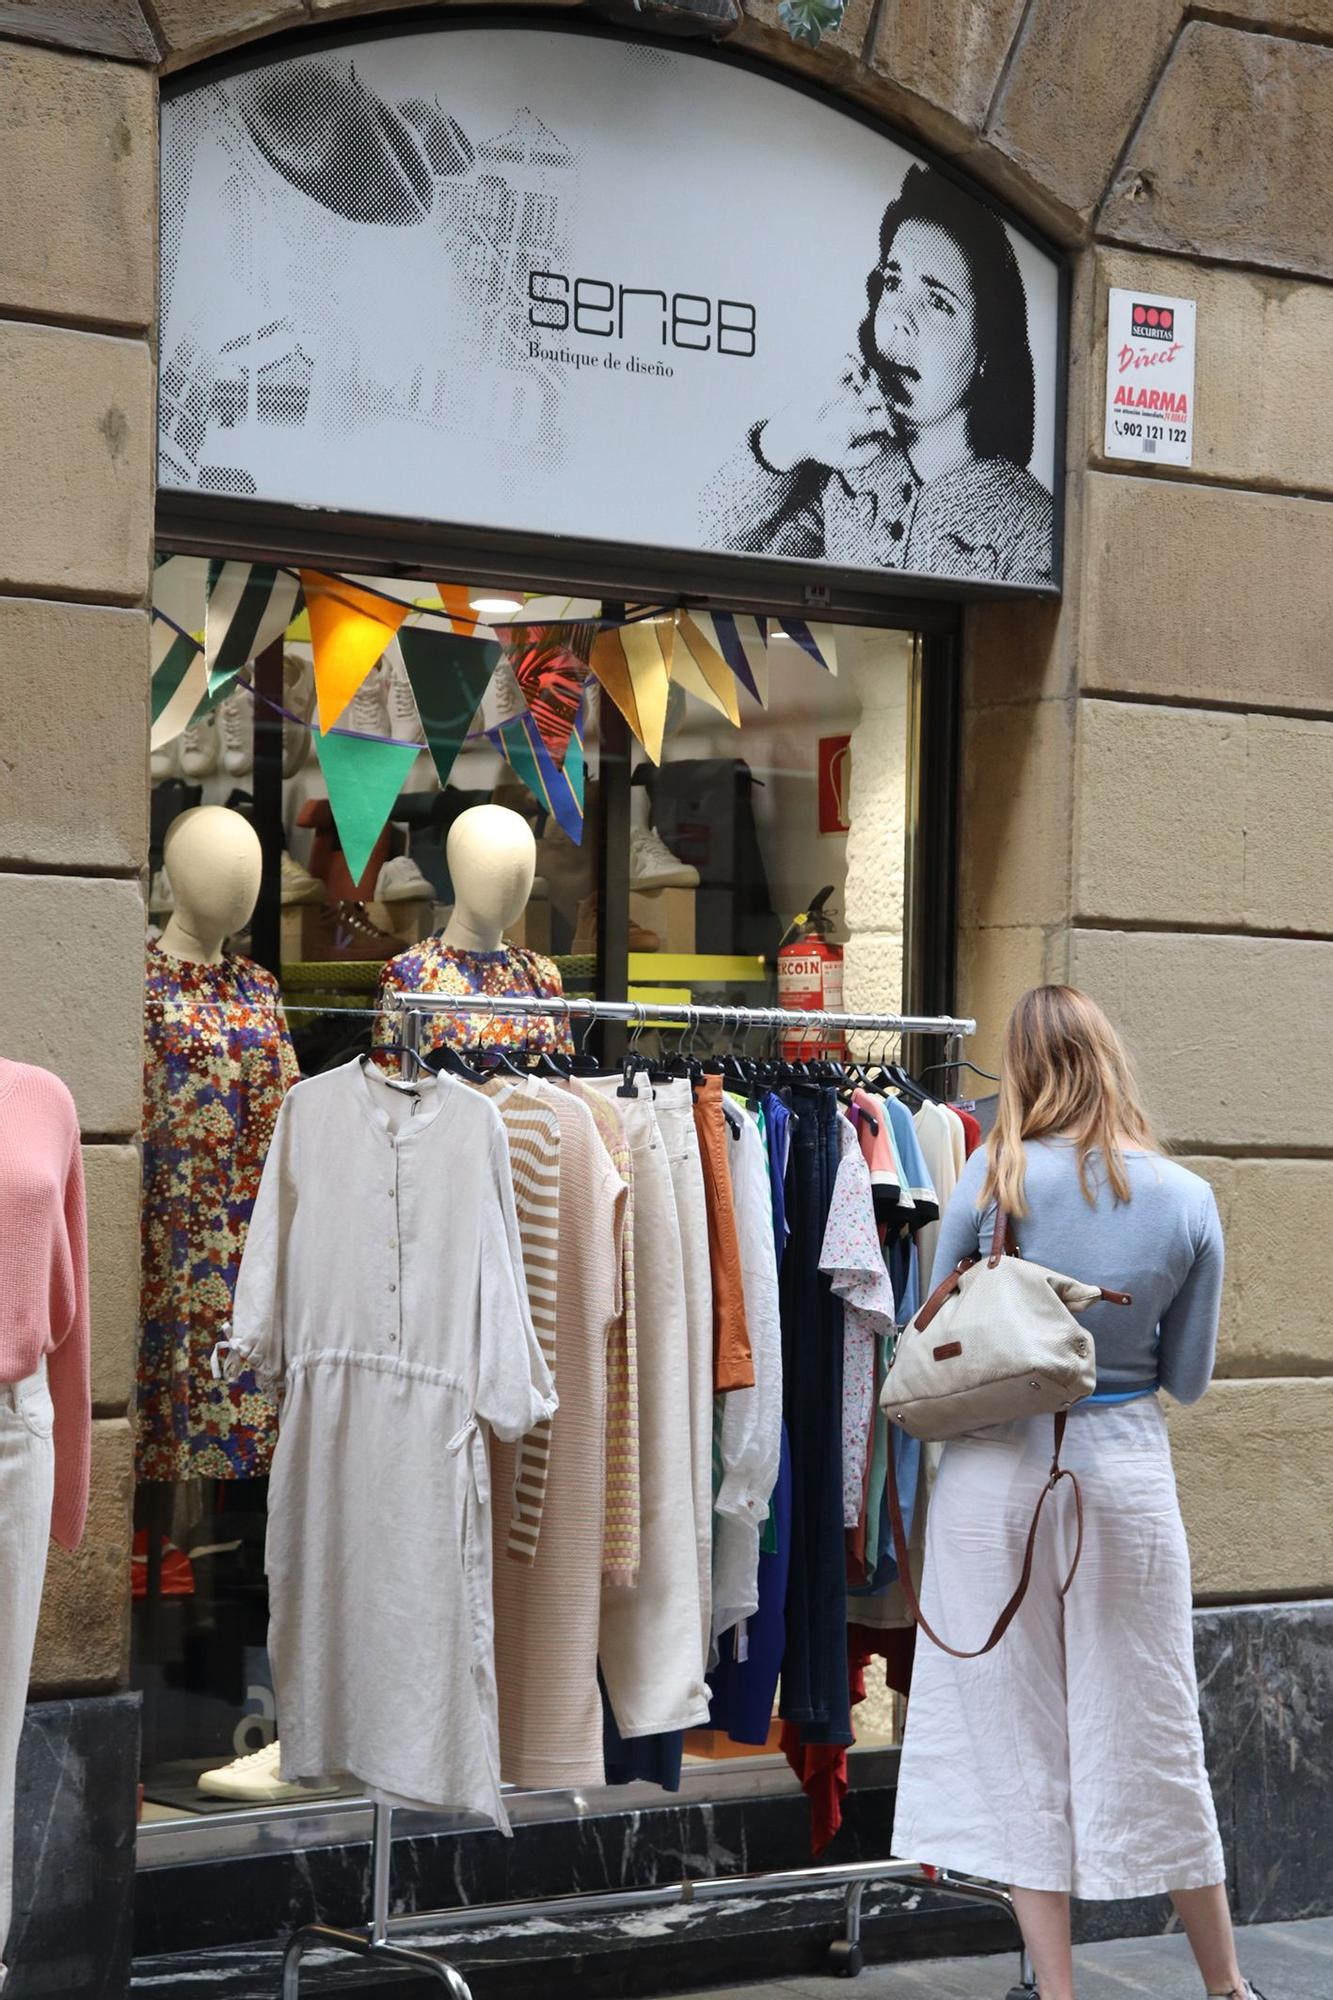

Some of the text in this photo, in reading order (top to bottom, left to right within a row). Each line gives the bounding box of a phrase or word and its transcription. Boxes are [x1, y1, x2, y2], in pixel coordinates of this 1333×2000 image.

[1132, 325, 1173, 340] SECURITAS
[528, 341, 674, 378] Boutique de diseño
[1117, 342, 1184, 373] Direct
[1113, 385, 1188, 414] ALARMA
[1123, 422, 1187, 443] 902 121 122
